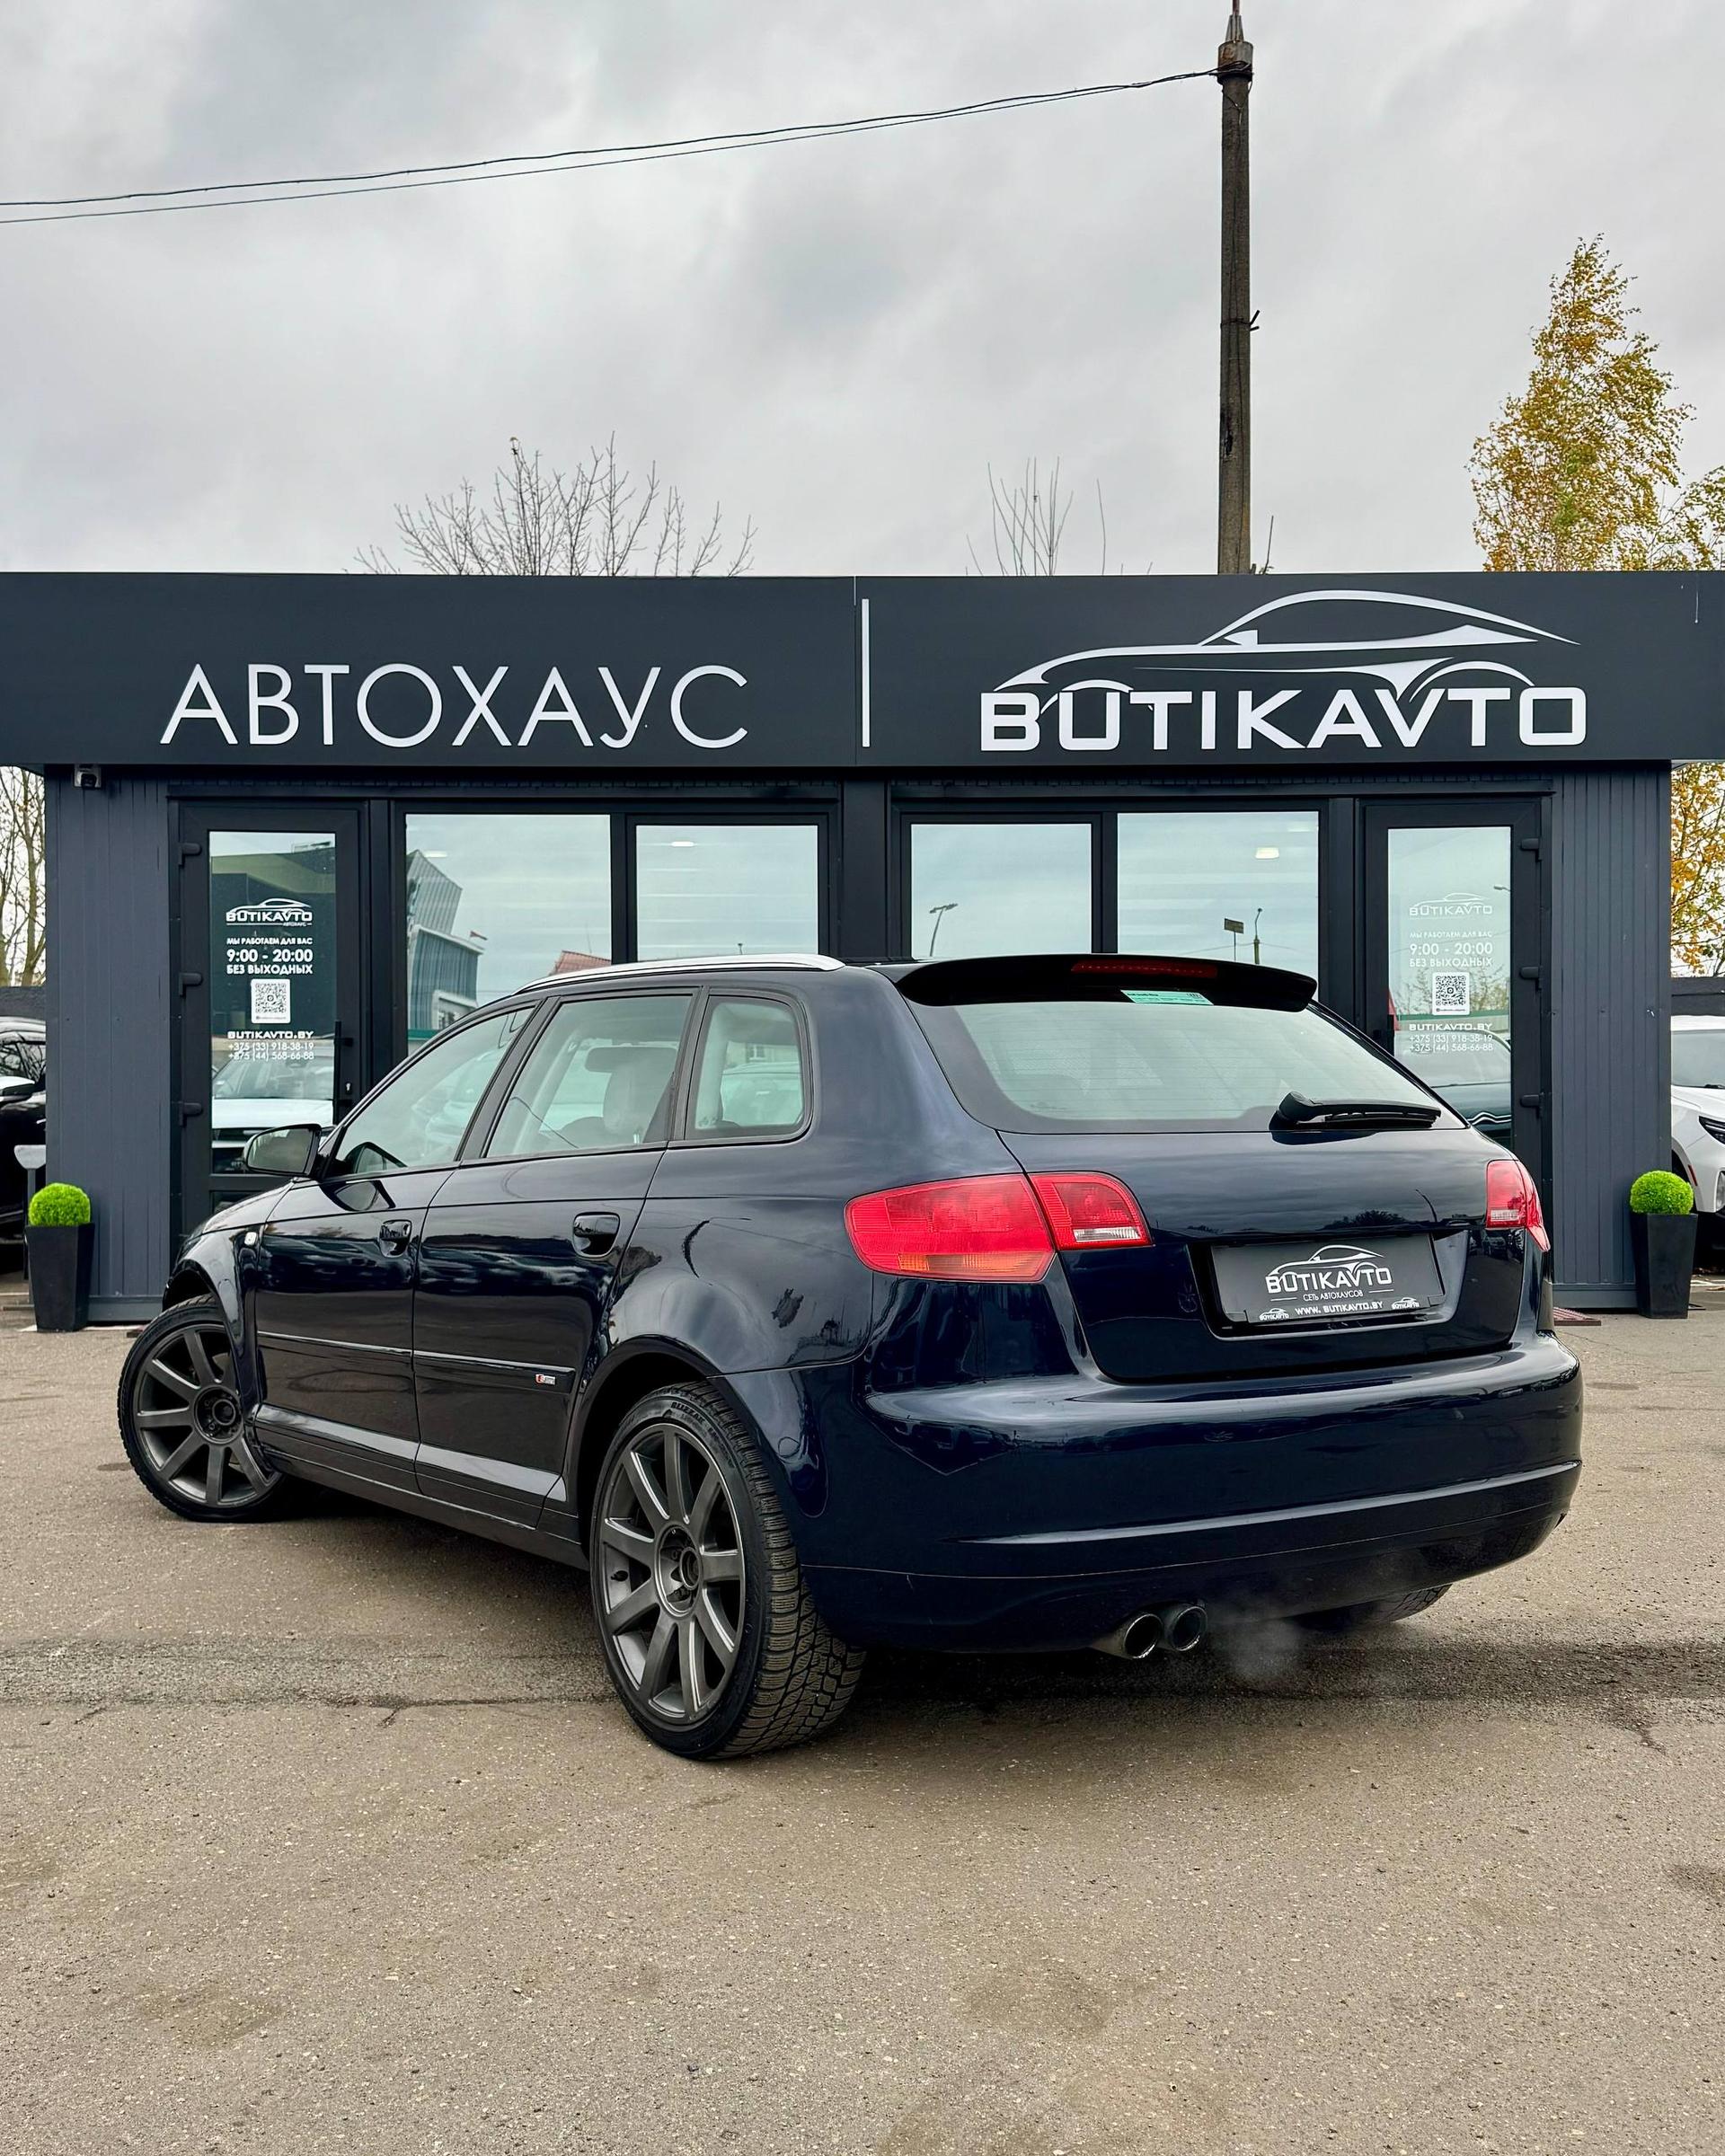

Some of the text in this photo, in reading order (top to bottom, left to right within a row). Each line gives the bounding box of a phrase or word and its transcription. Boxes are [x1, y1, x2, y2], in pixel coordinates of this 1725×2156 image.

[160, 663, 748, 748] АВТОХАУС
[980, 685, 1587, 752] BUTIKAVTO
[1409, 906, 1492, 915] BUTIKAVTO
[226, 911, 313, 922] BUTIKAVTO
[1410, 943, 1439, 955] 9:00
[1455, 942, 1492, 955] 20:00
[226, 949, 258, 962] 9:00
[272, 949, 313, 962] 20:00
[1410, 957, 1493, 968] БЕЗ ВЫХОДНЫХ
[226, 964, 313, 975] БЕЗ ВЫХОДНЫХ
[1409, 1023, 1492, 1031] BUTIKAVTO.BY
[252, 1042, 269, 1052] (33)
[271, 1042, 314, 1051] 918-38-19
[252, 1051, 269, 1061] (44)
[1265, 1267, 1393, 1294] BUTIKAVTO
[1320, 1290, 1363, 1301] АВТОХАУСОВ
